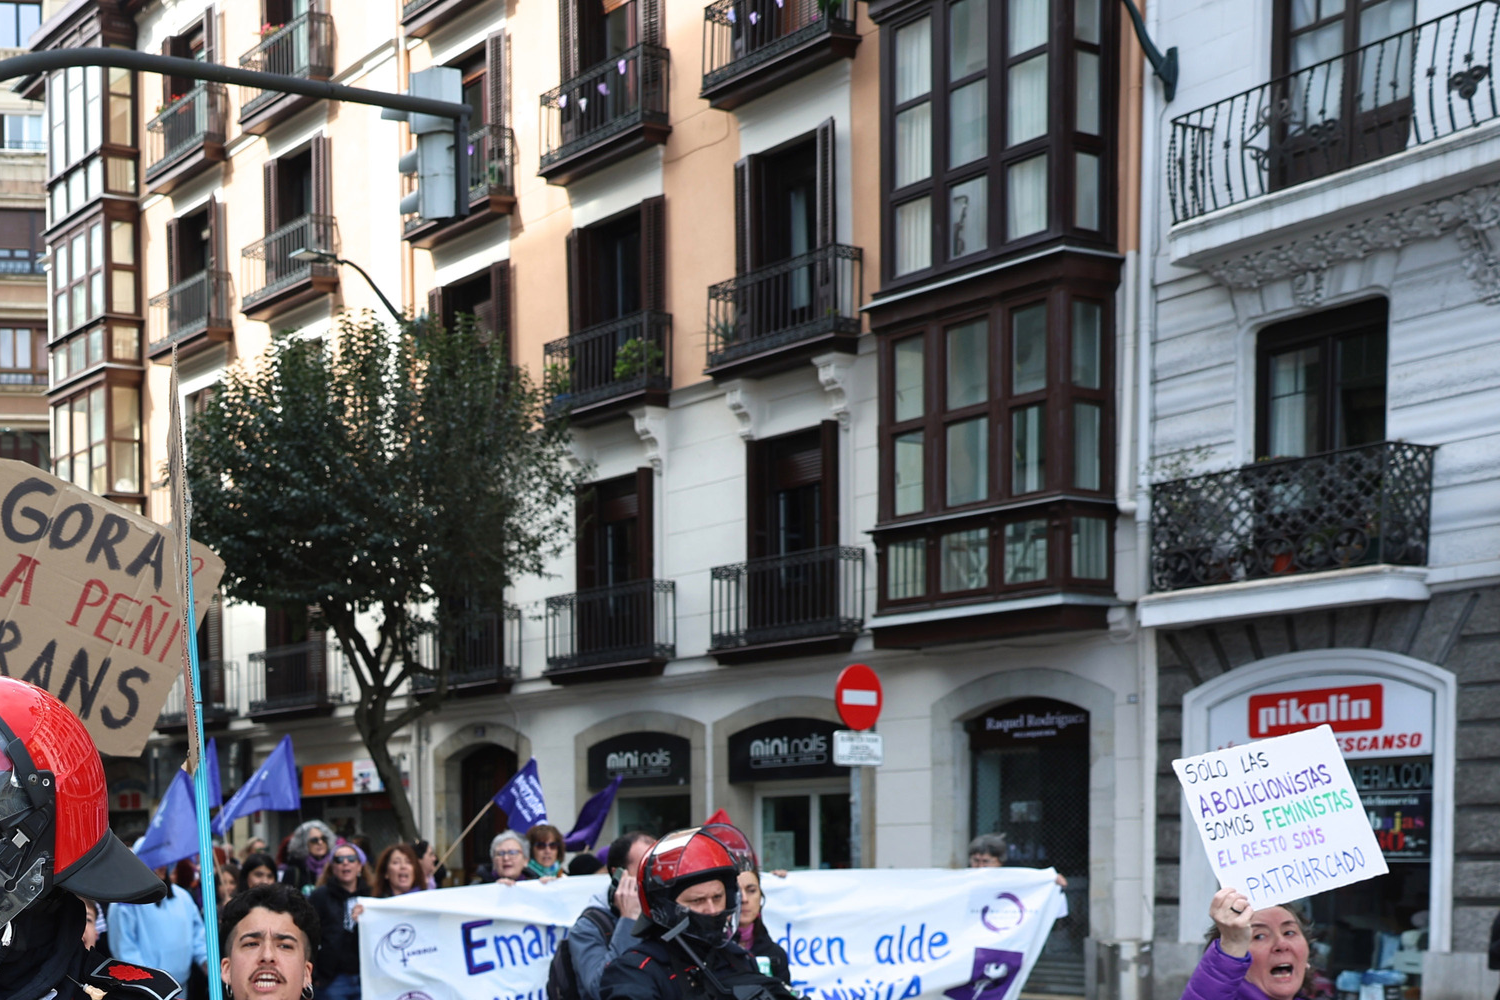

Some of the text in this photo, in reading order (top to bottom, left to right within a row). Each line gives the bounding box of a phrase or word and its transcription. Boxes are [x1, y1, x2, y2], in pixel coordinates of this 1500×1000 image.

[0, 477, 165, 592] GORA
[1258, 694, 1371, 735] pikolin
[750, 736, 788, 757] mini
[790, 732, 827, 754] nails
[1337, 733, 1423, 752] ESCANSO
[606, 748, 671, 769] mini nails
[1240, 752, 1269, 773] LAS
[1205, 813, 1254, 841] SOMOS
[1368, 810, 1425, 835] bajas
[1217, 849, 1237, 869] EL
[1241, 836, 1288, 863] RESTO
[1245, 846, 1366, 901] PATRIARCADO
[461, 919, 952, 976] Emak deen alde
